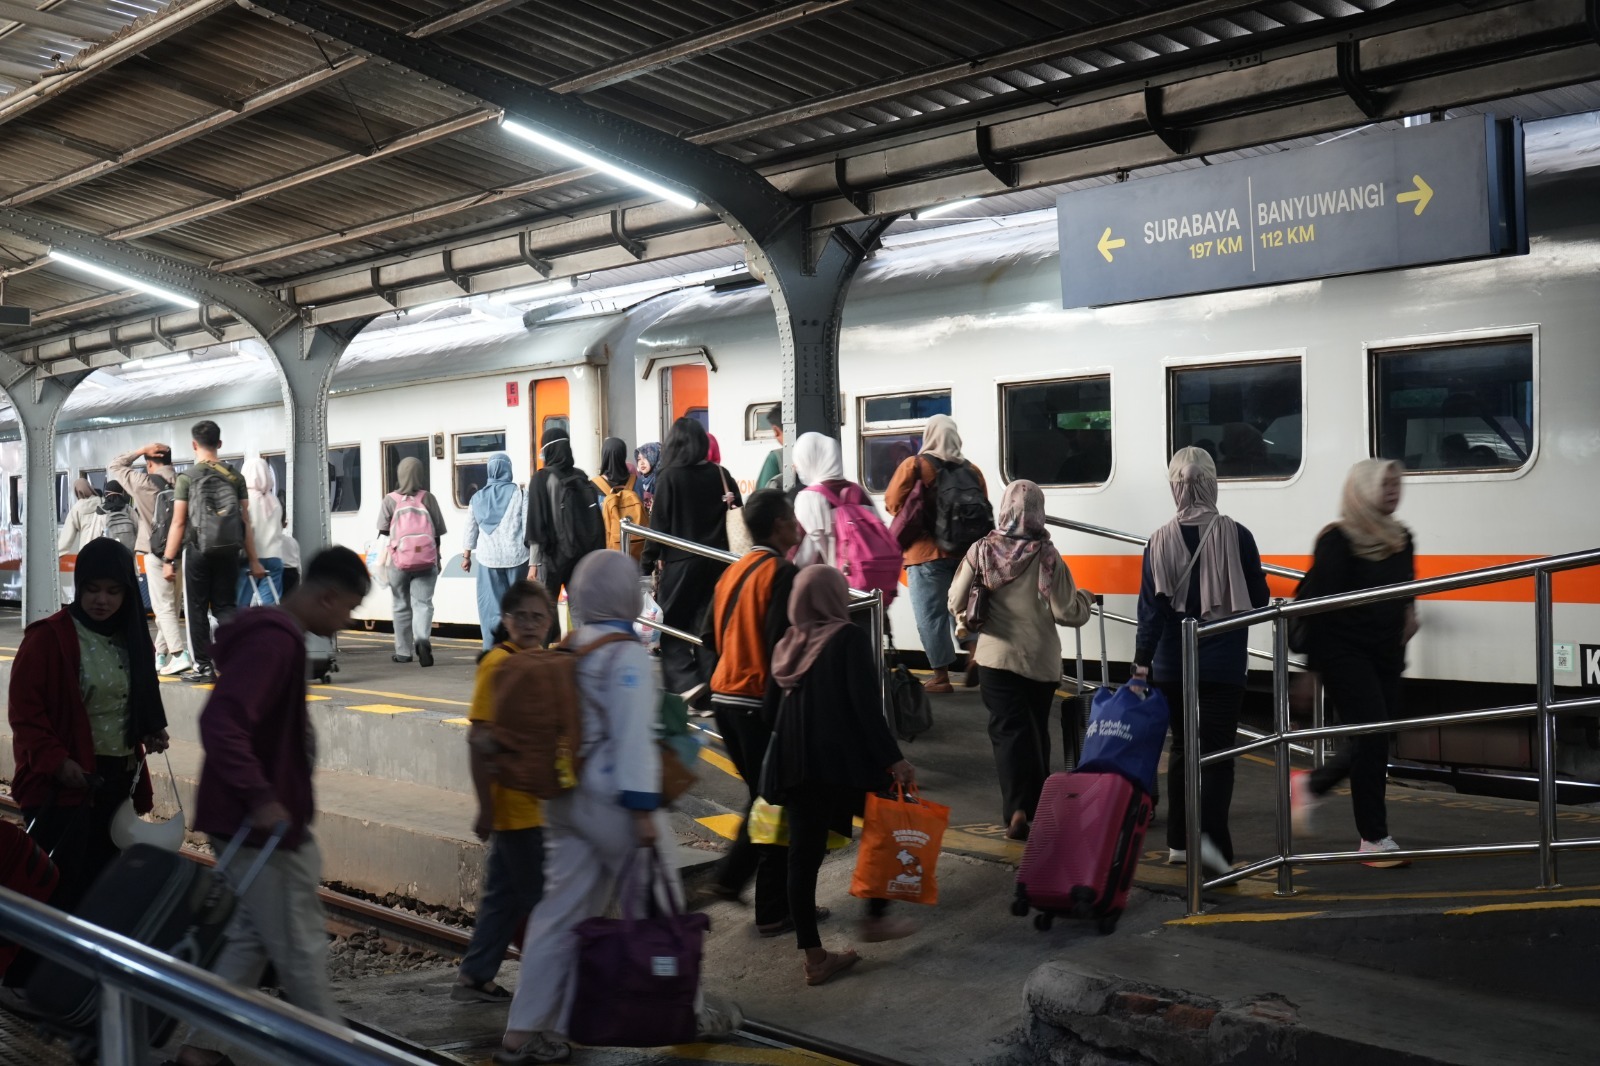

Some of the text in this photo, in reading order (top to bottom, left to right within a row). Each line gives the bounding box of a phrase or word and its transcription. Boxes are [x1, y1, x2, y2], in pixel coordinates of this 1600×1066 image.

[1258, 182, 1385, 226] BANYUWANGI
[1144, 207, 1240, 244] SURABAYA
[1260, 224, 1315, 248] 112 KM
[1189, 235, 1243, 259] 197 KM
